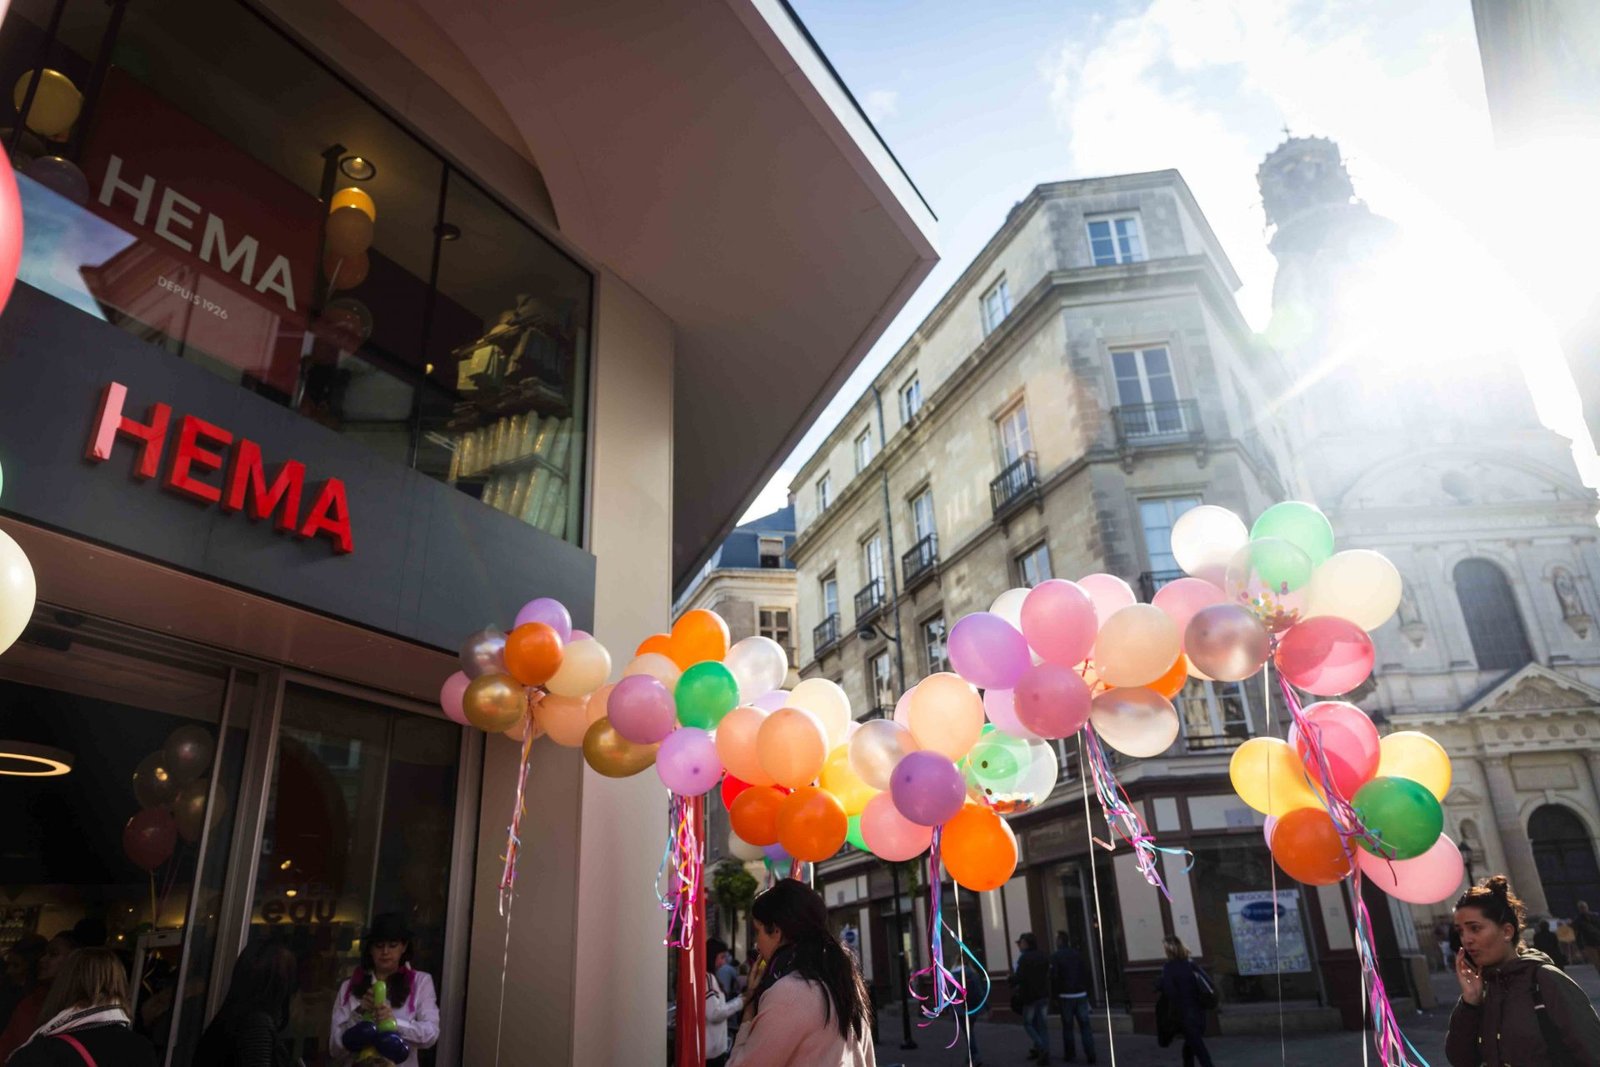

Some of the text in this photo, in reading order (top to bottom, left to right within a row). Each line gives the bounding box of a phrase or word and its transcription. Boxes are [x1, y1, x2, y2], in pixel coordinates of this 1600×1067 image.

[98, 154, 296, 312] HEMA
[158, 275, 229, 321] DEPUIS 1926
[86, 381, 354, 554] HEMA
